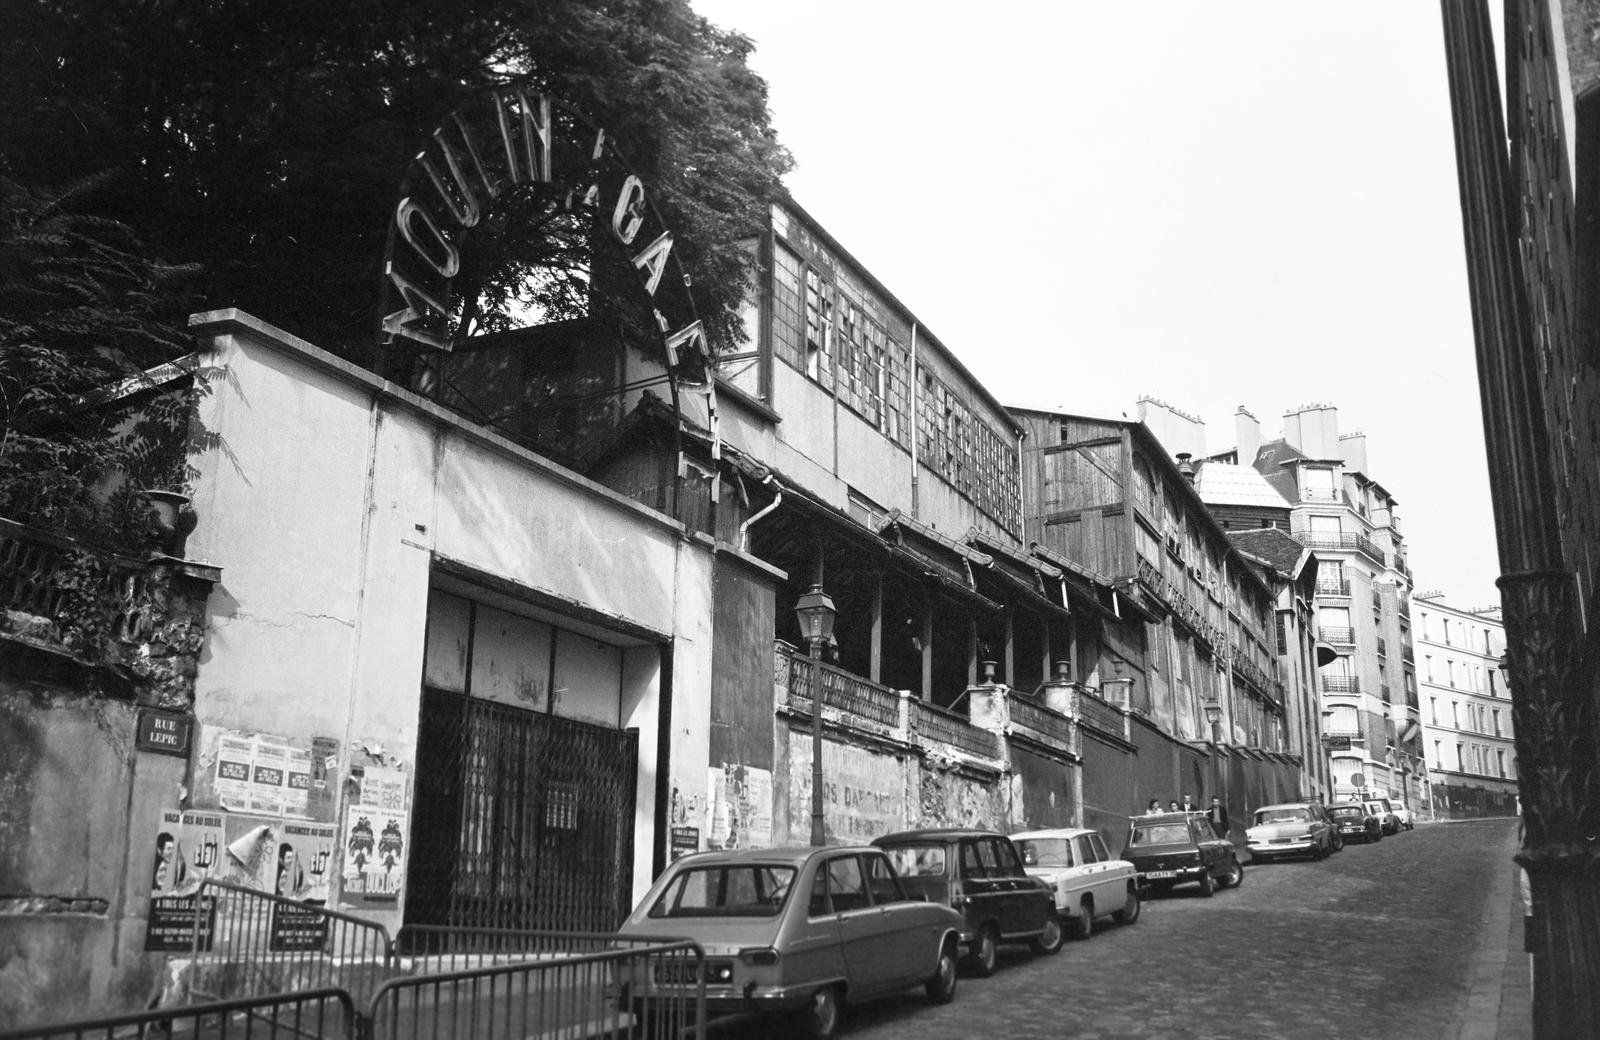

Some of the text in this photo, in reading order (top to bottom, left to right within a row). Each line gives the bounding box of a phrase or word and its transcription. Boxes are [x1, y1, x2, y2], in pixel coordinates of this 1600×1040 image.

[382, 88, 552, 353] MOULIN
[612, 174, 721, 504] GALETTE
[154, 718, 176, 731] RUE
[150, 731, 178, 745] LEPIC
[164, 813, 222, 828] VACACES AU SOLEIL
[284, 825, 333, 838] VACANCES AU SOLEIL
[162, 899, 177, 909] TOUS
[178, 899, 189, 909] LES
